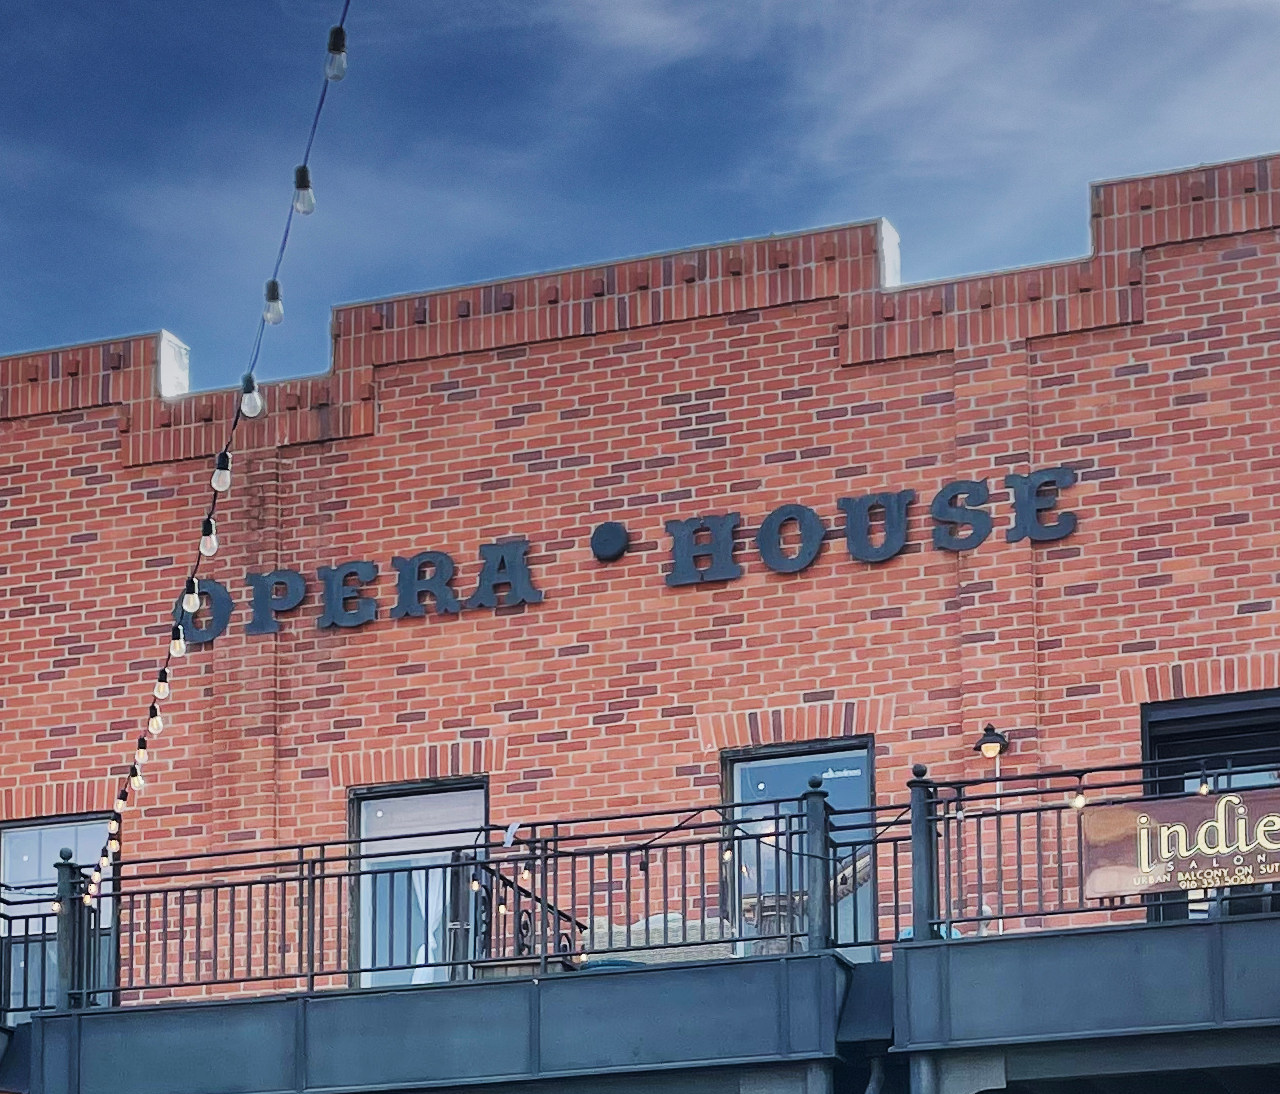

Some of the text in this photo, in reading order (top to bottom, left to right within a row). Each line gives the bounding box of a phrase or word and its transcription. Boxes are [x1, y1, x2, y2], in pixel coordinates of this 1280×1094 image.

[176, 465, 1078, 644] OPERA HOUSE
[1166, 854, 1267, 873] SALON
[1133, 874, 1171, 886] URBAN
[1177, 867, 1228, 881] BALCONY
[1235, 864, 1253, 875] ON
[1179, 879, 1198, 890] 916
